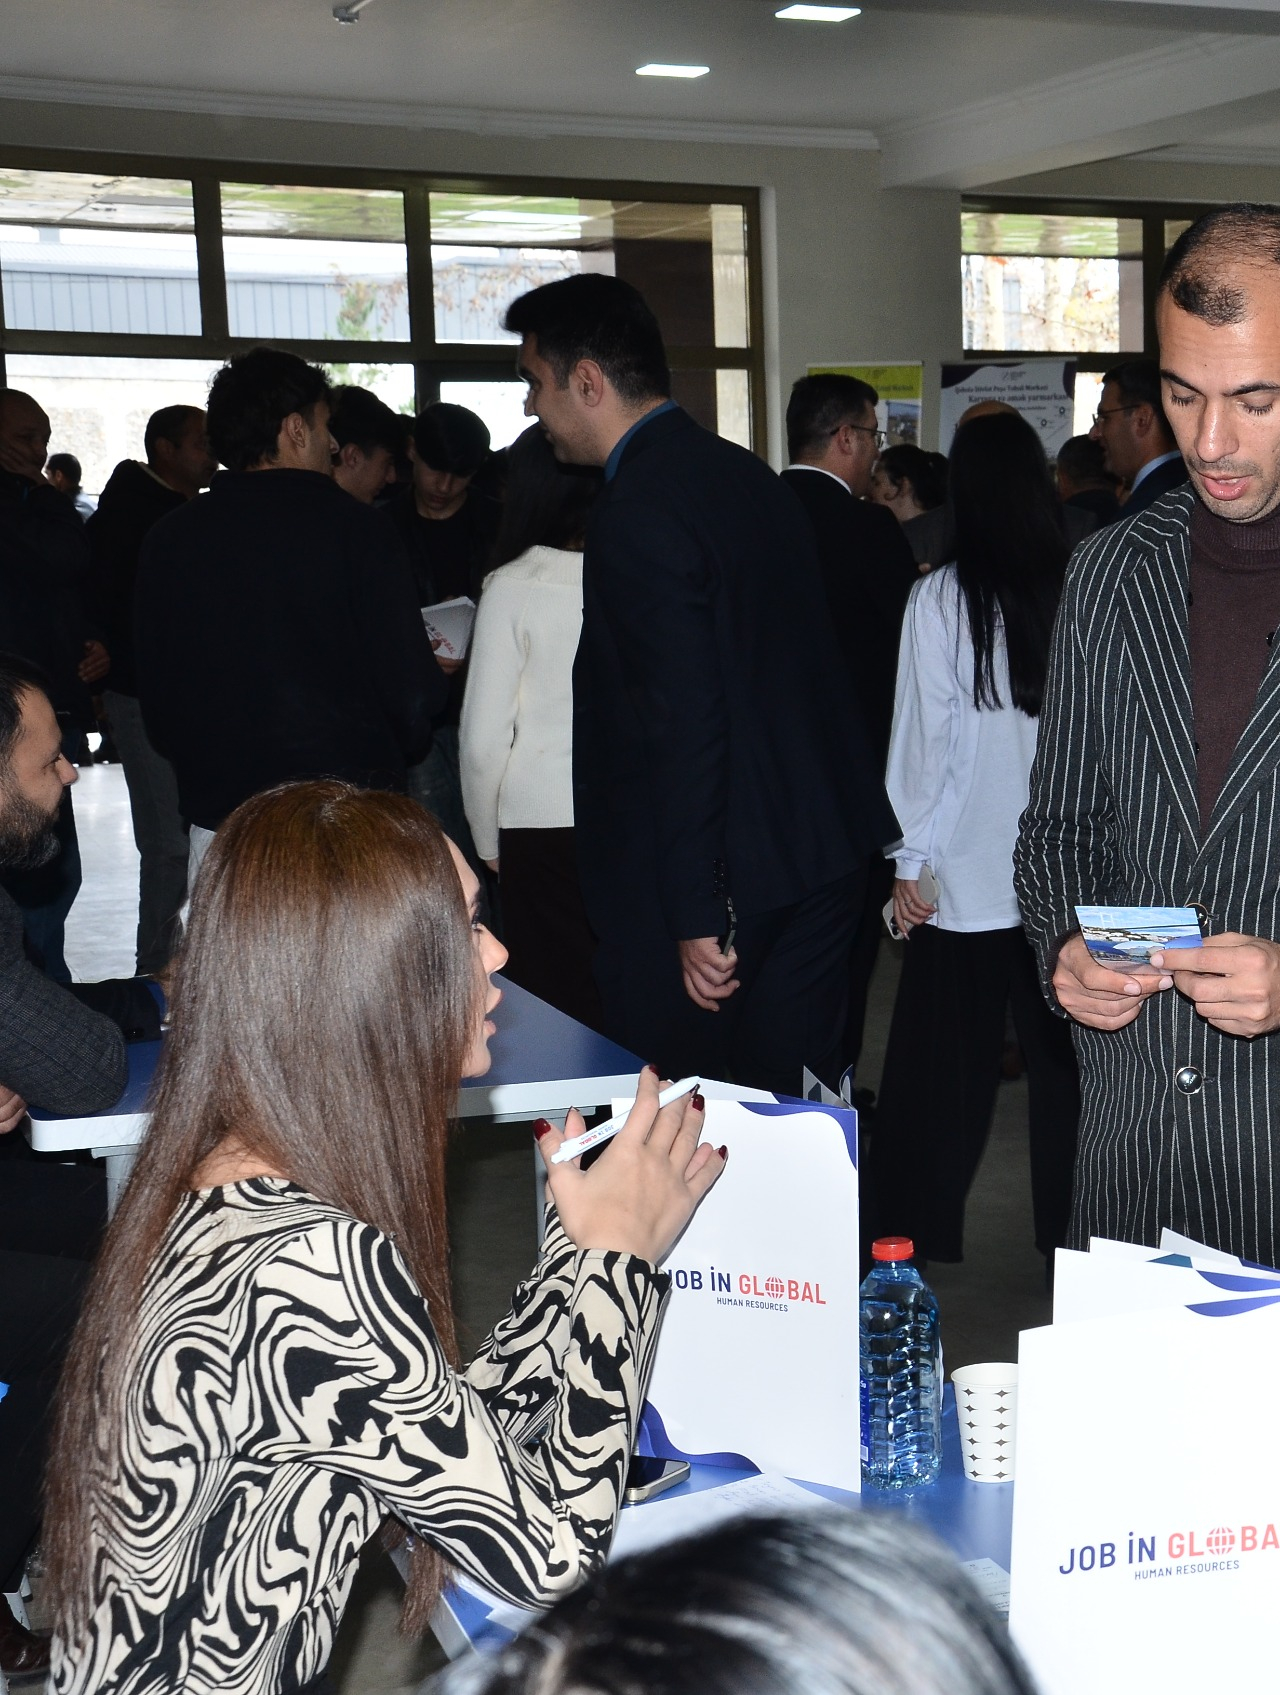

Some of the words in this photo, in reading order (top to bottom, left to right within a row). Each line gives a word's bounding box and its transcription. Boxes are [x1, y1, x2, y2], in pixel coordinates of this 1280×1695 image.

[716, 1297, 744, 1307] HUMAN
[745, 1300, 789, 1312] RESOURCES
[1059, 1542, 1116, 1575] JOB
[1134, 1567, 1173, 1580] HUMAN
[1176, 1560, 1240, 1575] RESOURCES
